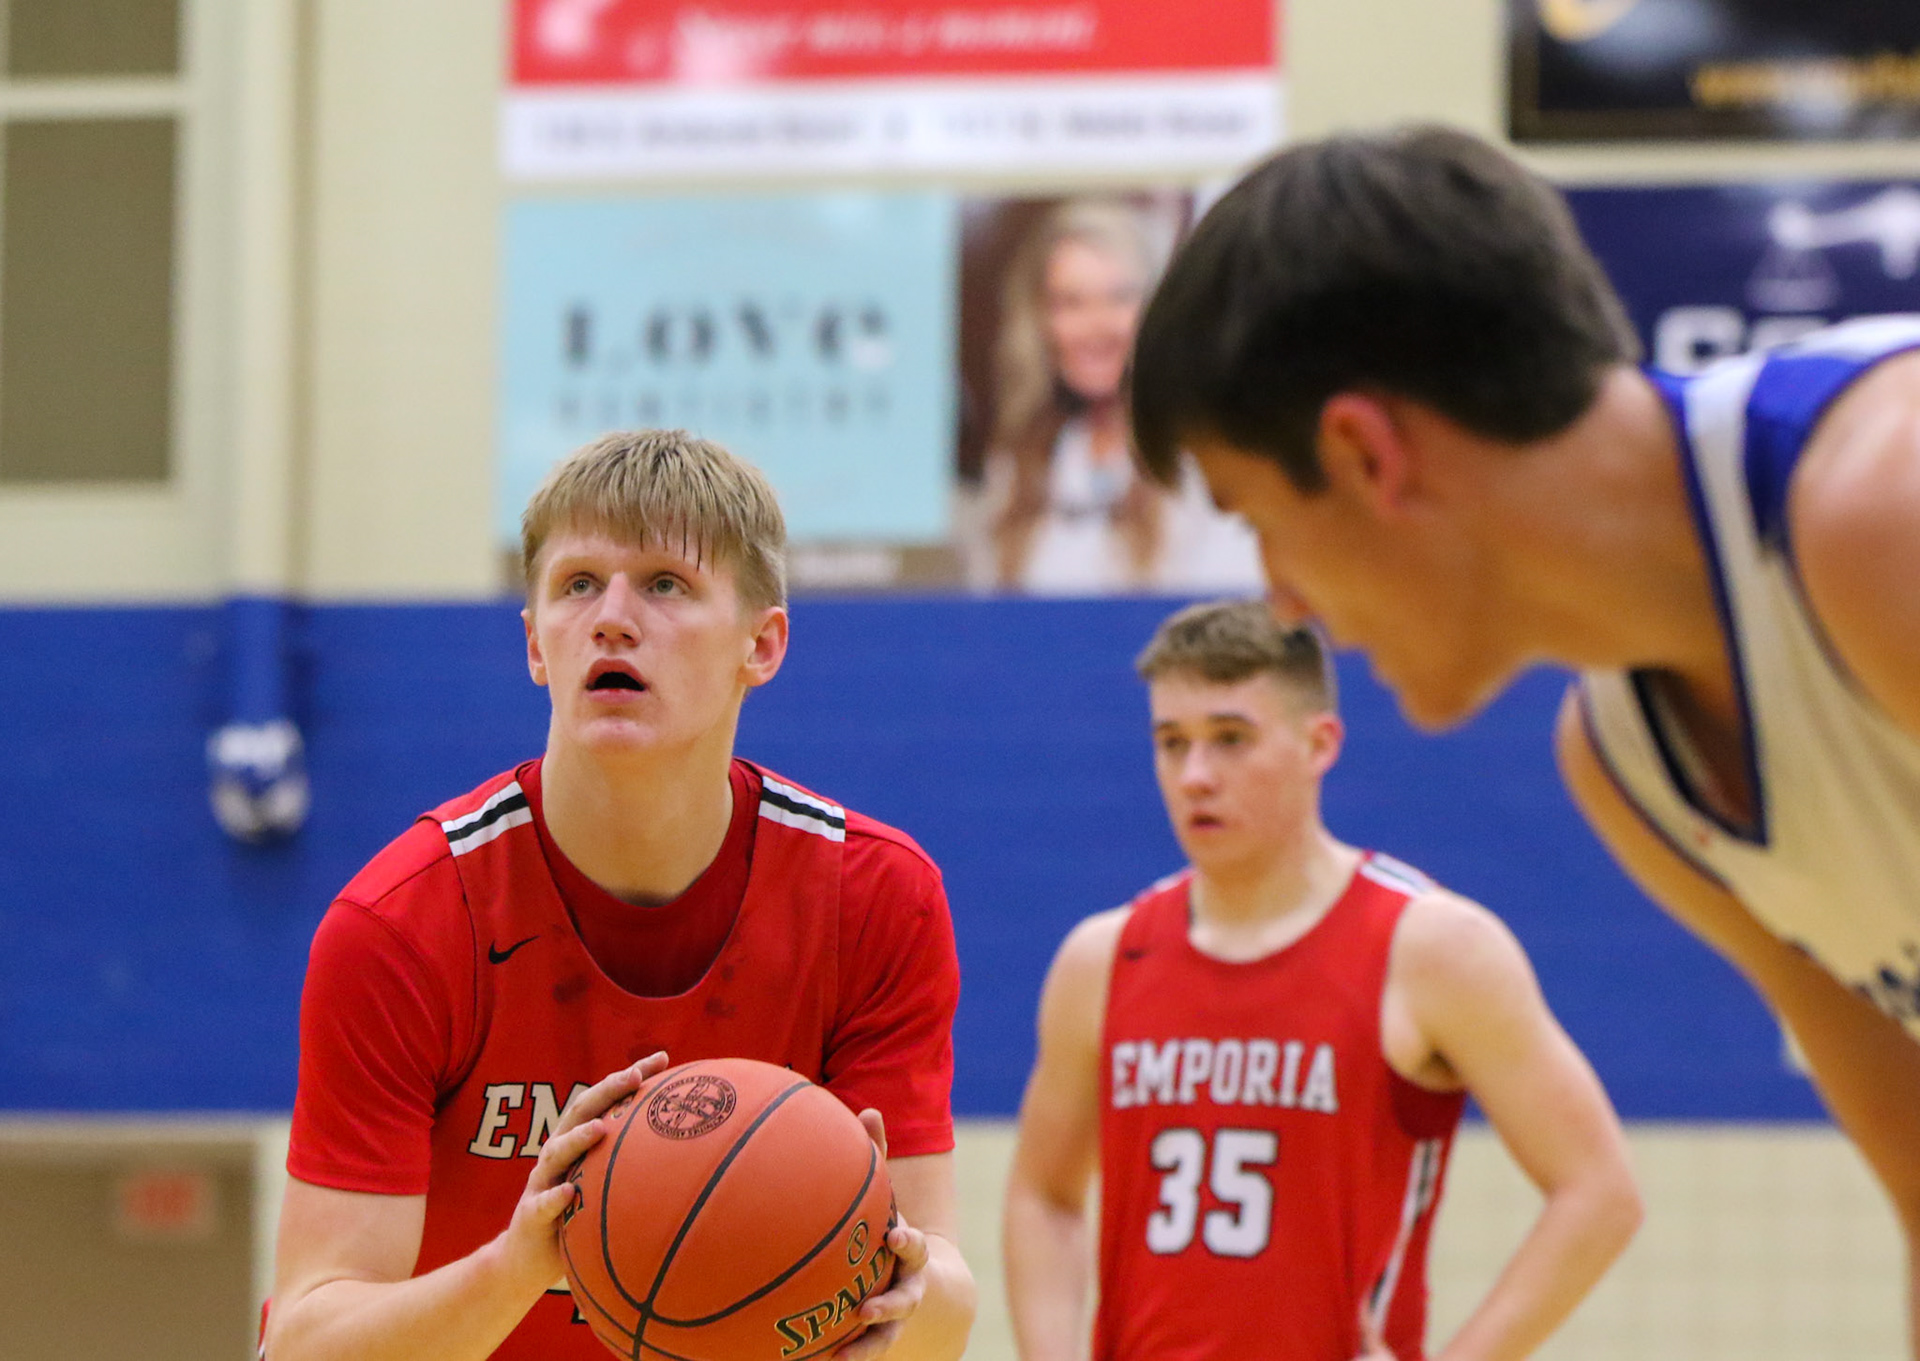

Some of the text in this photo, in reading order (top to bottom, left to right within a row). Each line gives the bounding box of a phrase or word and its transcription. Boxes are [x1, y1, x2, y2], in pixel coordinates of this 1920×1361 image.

[1112, 1038, 1339, 1115] EMPORIA
[1145, 1126, 1280, 1259] 35
[774, 1244, 888, 1358] SPALD
